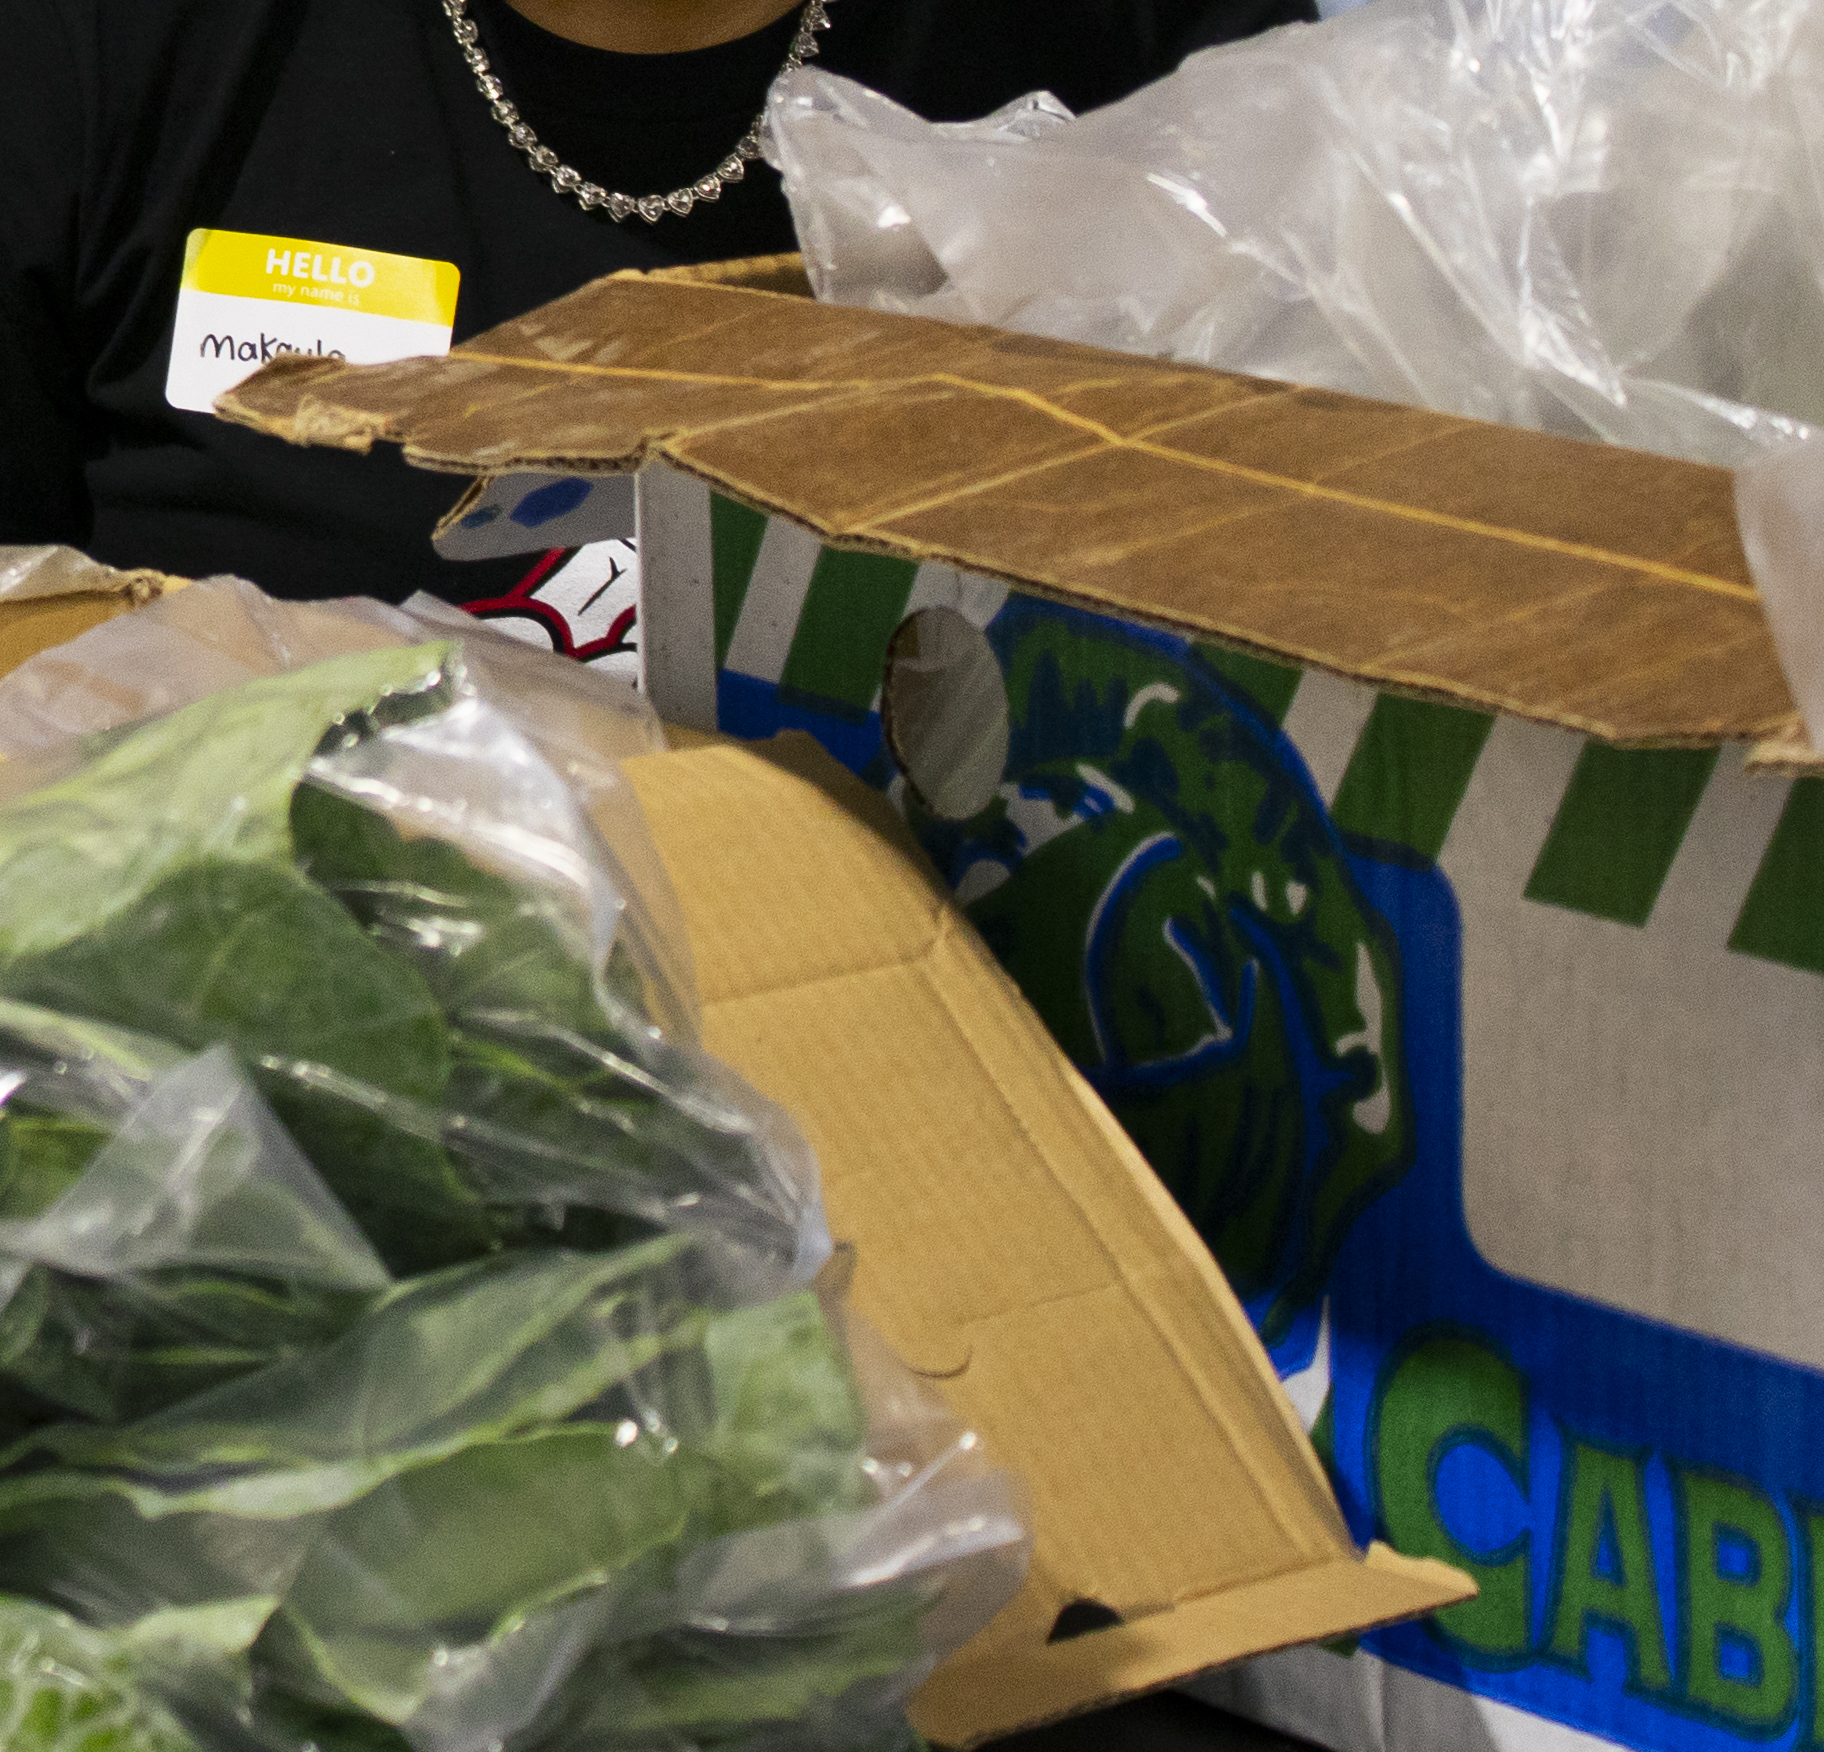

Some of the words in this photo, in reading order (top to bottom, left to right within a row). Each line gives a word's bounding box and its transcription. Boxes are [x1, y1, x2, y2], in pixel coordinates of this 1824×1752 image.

[266, 248, 375, 288] HELLO
[273, 282, 295, 298] my
[301, 284, 345, 303] name
[348, 292, 360, 306] is
[1371, 1320, 1824, 1742] CAB
